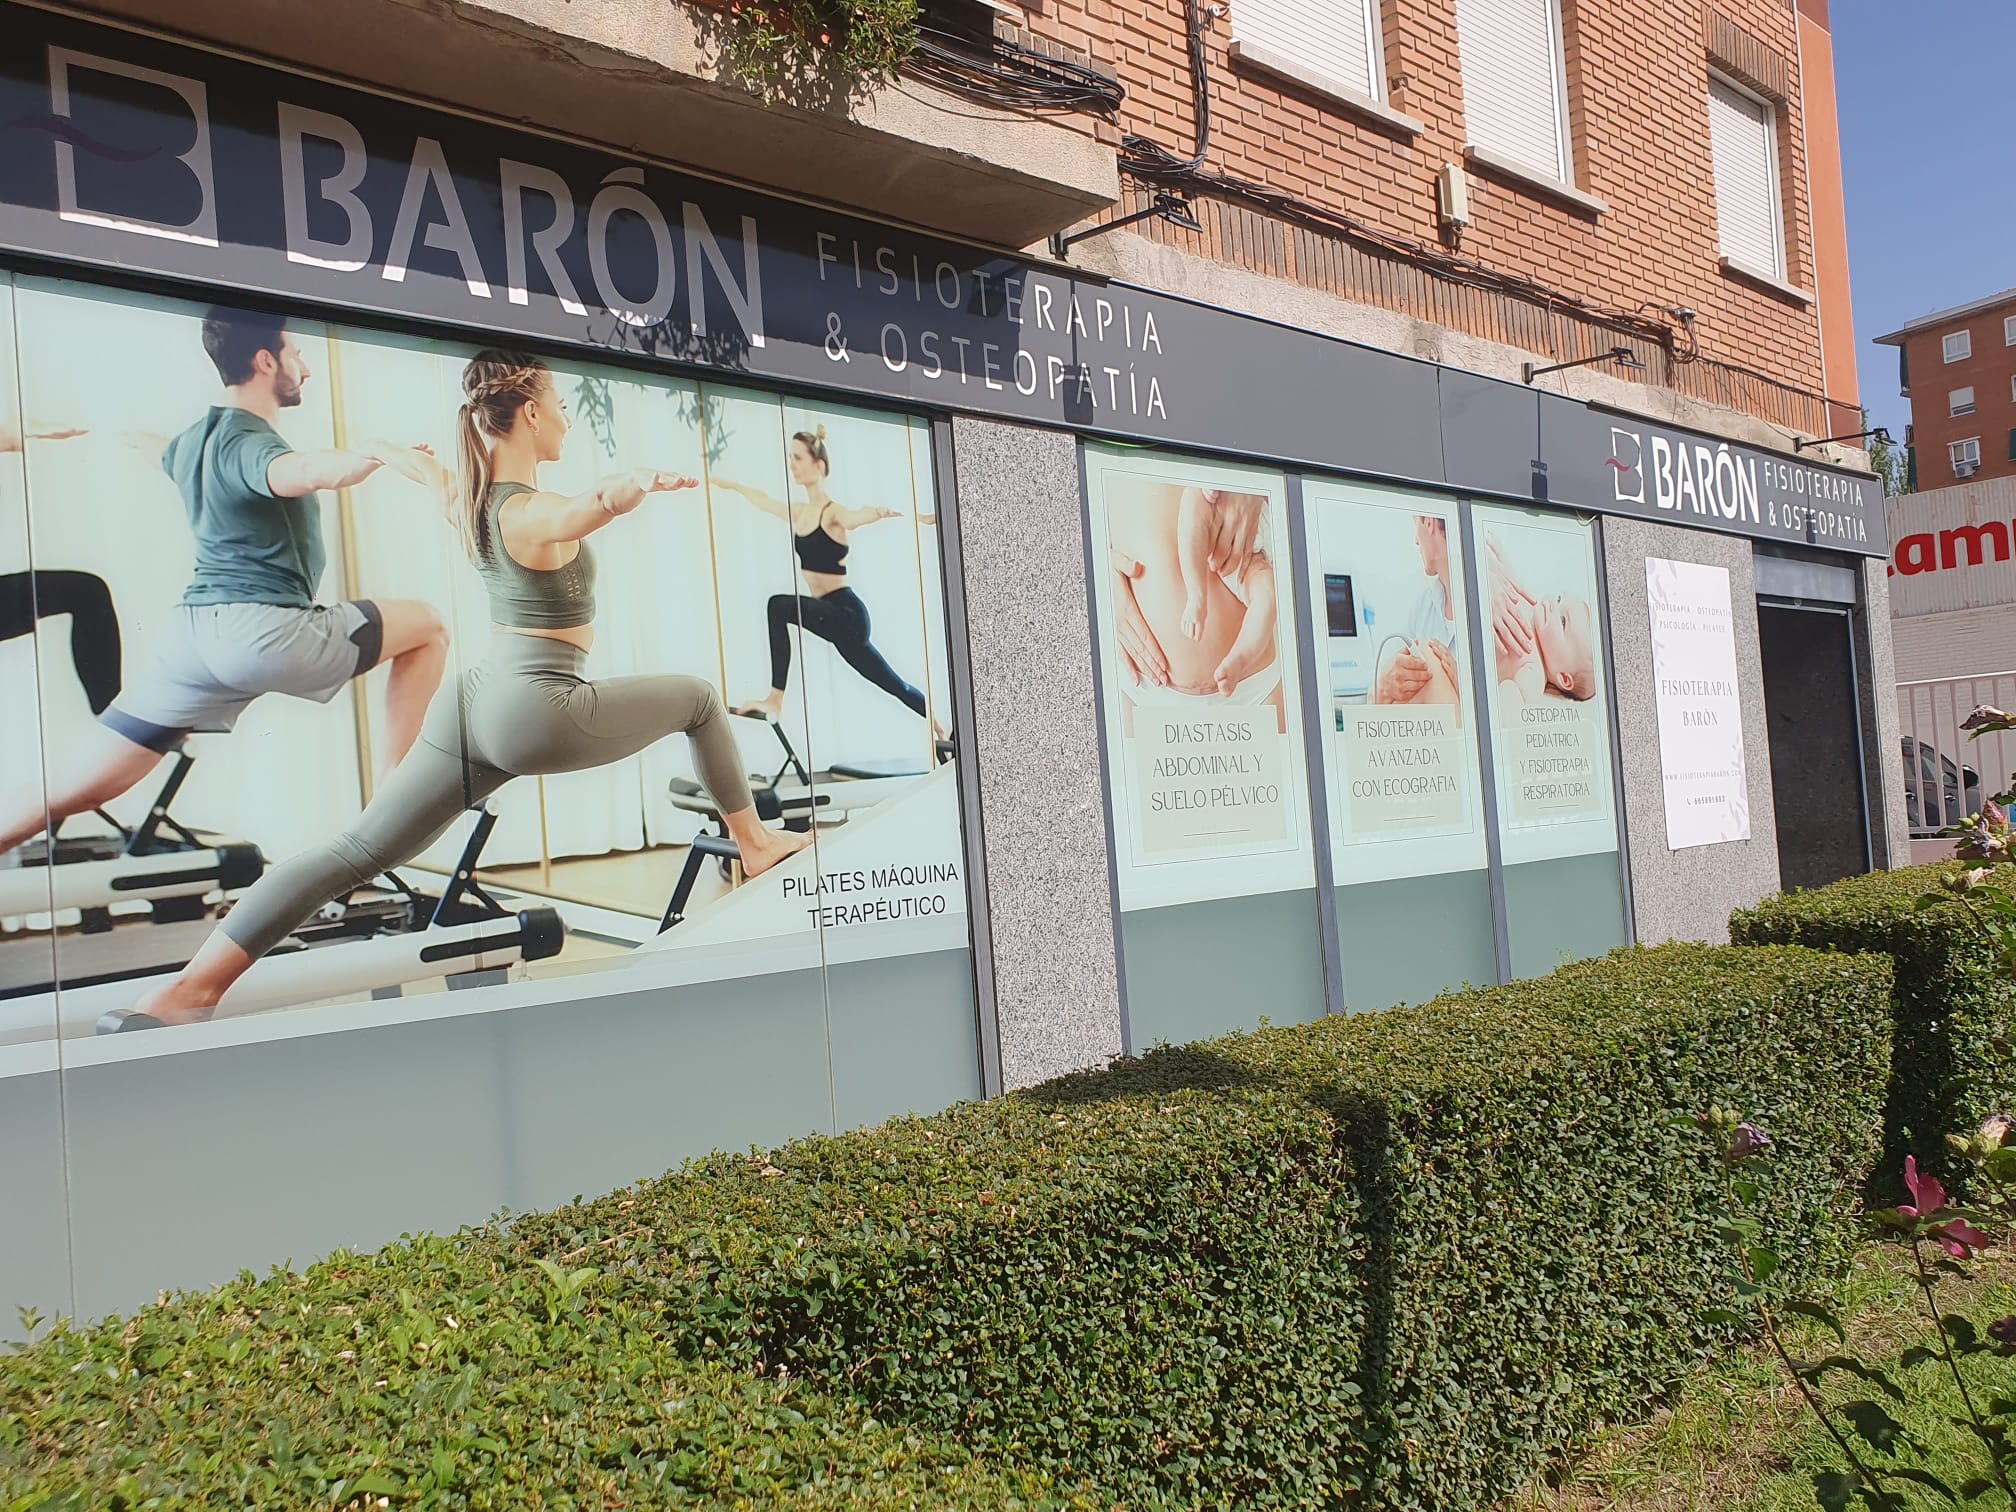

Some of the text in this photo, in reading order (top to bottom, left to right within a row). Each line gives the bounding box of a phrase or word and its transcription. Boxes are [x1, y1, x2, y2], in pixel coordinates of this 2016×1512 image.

[277, 101, 766, 348] BARÓN
[816, 231, 1163, 355] FISIOTERAPIA
[824, 312, 1168, 421] & OSTEOPATÍA
[1652, 436, 1760, 524] BARÓN
[1764, 461, 1864, 507] FISIOTERAPIA
[1769, 500, 1867, 543] & OSTEOPATÍA
[1887, 518, 2016, 578] am
[1661, 679, 1733, 697] FISIOTERAPIA
[1357, 719, 1445, 739] FISIOTERAPIA
[1682, 709, 1718, 727] BARÓN
[1165, 722, 1252, 744] DIASTASIS
[1153, 753, 1263, 778] ABDOMINAL Y
[1368, 747, 1440, 768] AVANZADA
[1520, 758, 1590, 775] Y FISIOTERAPIA
[1151, 784, 1278, 812] SUELO PÉLVICO
[1352, 780, 1380, 798] CON
[1523, 782, 1590, 800] RESPIRATORIA
[783, 863, 958, 898] PILATES MÁQUINA
[807, 895, 946, 929] TERAPÉUTICO
